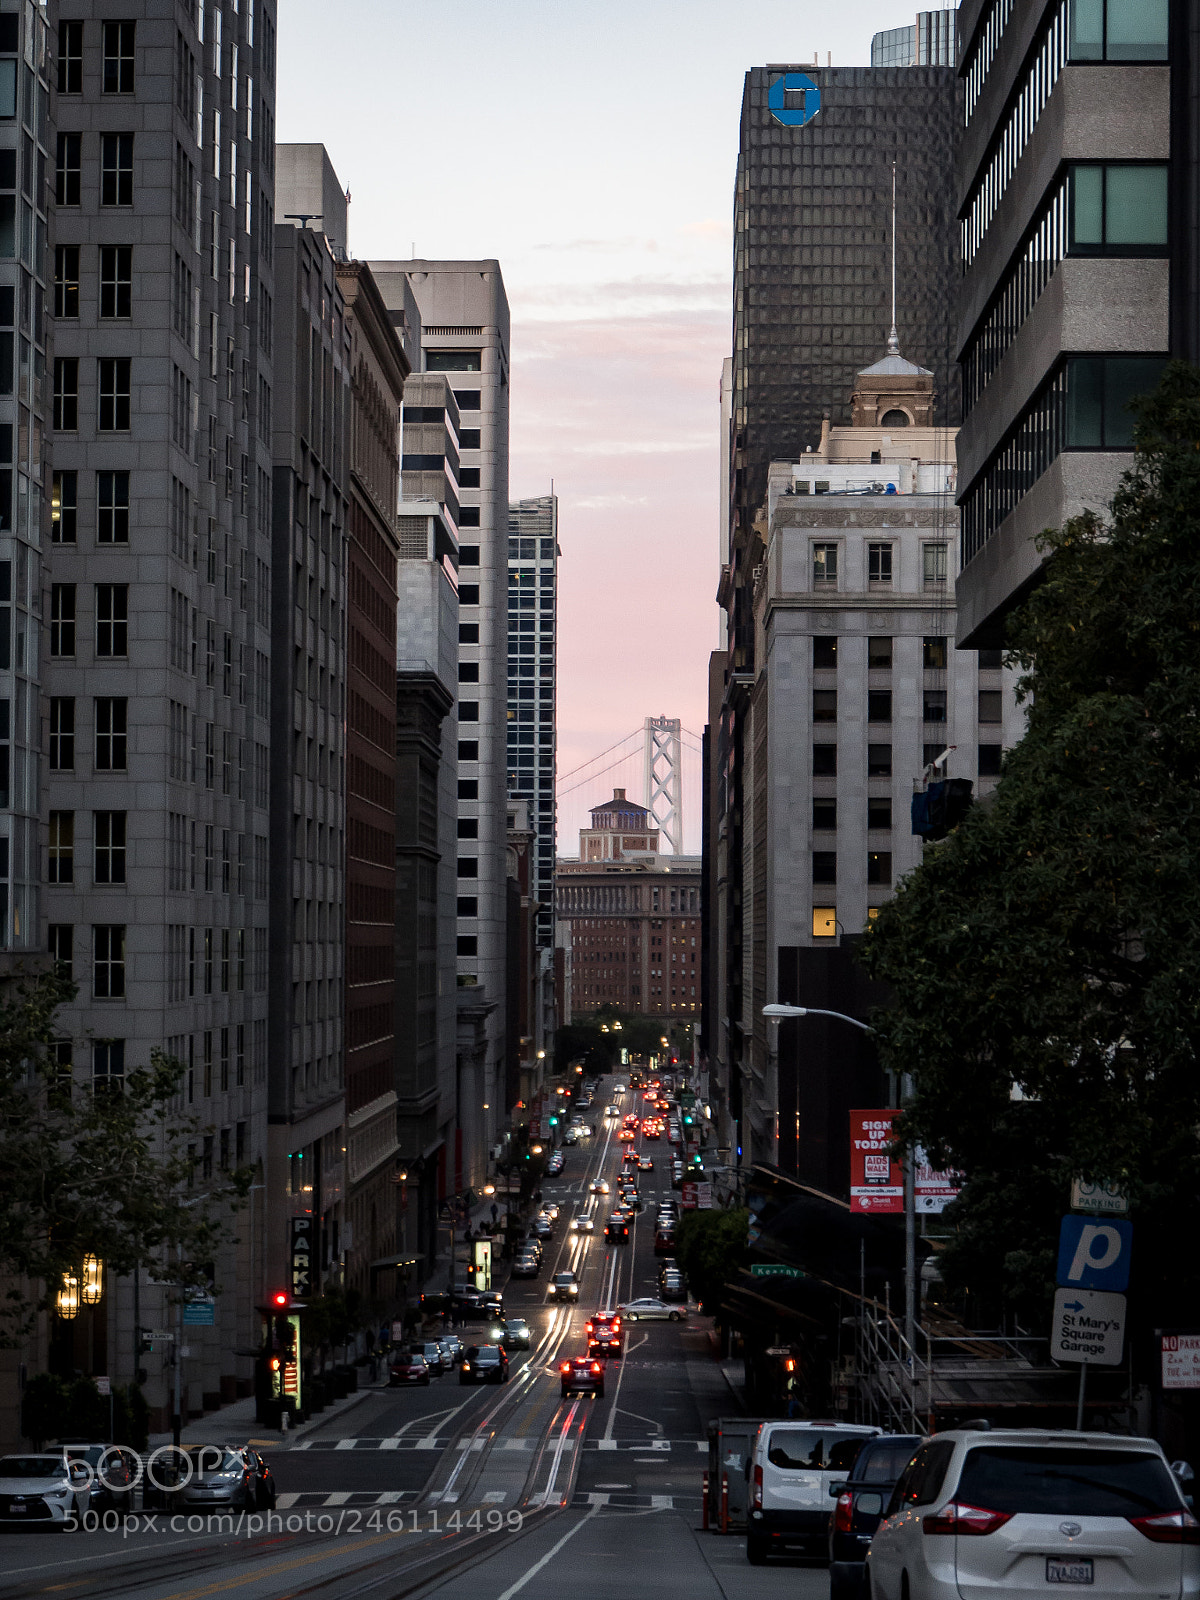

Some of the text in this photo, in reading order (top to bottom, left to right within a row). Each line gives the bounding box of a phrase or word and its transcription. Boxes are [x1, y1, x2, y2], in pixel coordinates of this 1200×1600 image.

[862, 1121, 892, 1130] SIGN
[869, 1131, 885, 1140] UP
[867, 1157, 887, 1165] AIDS
[1079, 1198, 1121, 1209] PARKING
[293, 1220, 310, 1284] PARK
[757, 1268, 799, 1278] Kearny
[1063, 1315, 1120, 1331] St Mary's
[1061, 1328, 1105, 1341] Square
[1060, 1340, 1105, 1355] Garage
[1162, 1336, 1177, 1350] NO
